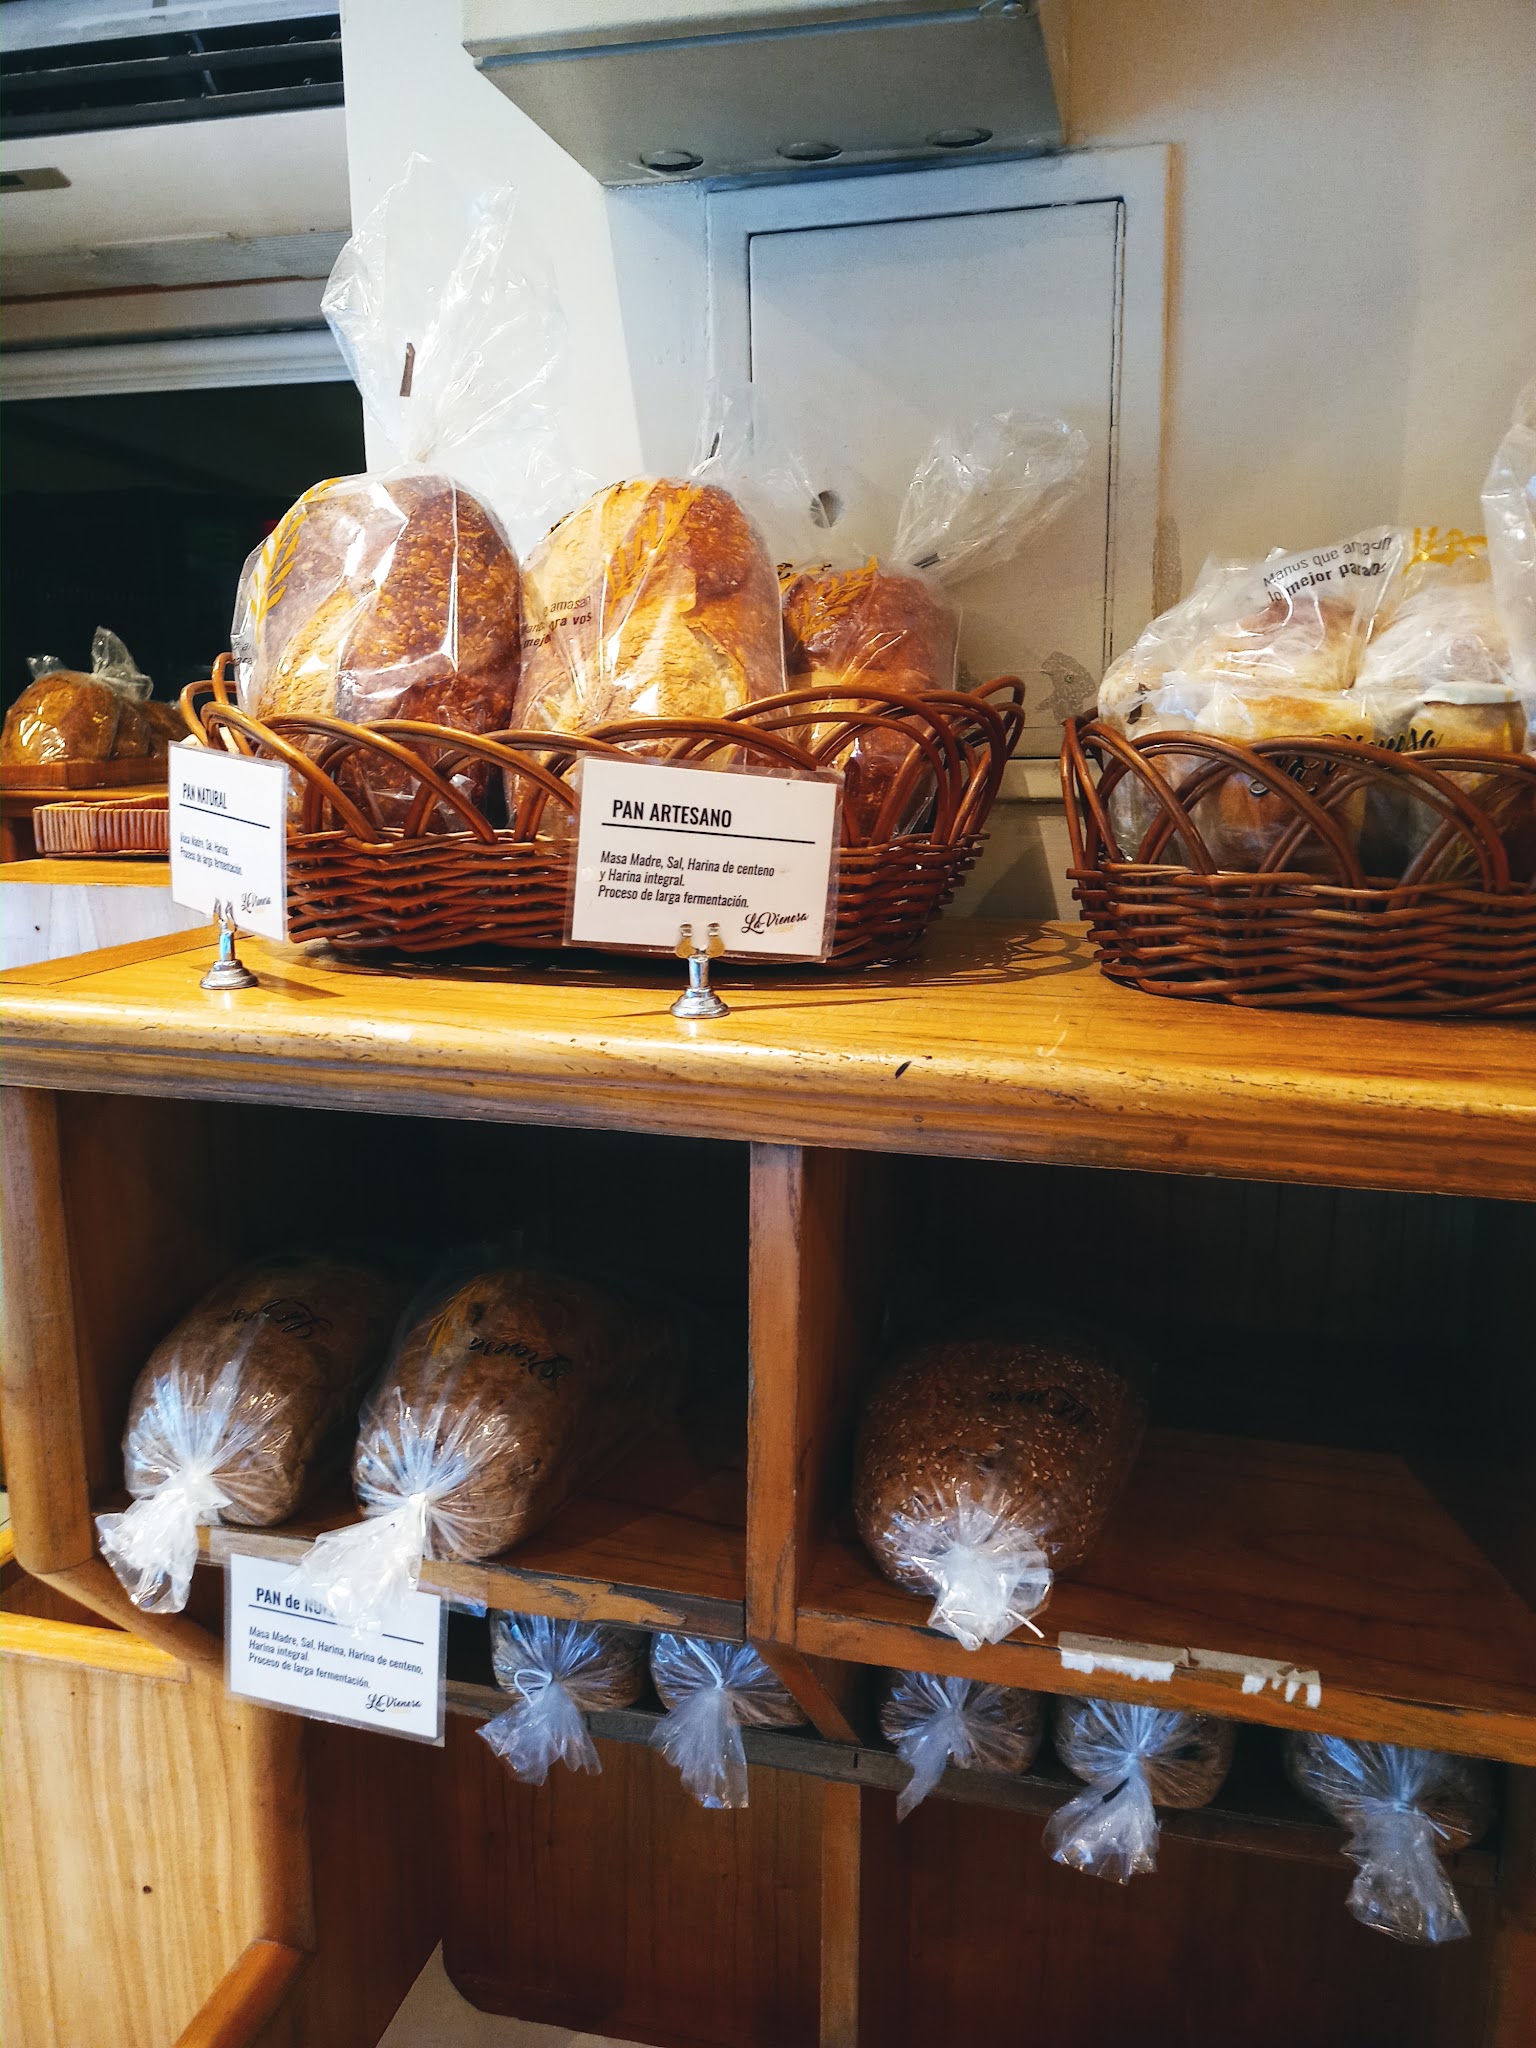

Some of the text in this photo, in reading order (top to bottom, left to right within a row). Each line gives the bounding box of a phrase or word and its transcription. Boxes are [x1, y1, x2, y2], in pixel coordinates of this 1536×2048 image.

[1312, 549, 1339, 567] que
[1268, 590, 1282, 603] lo
[1285, 571, 1333, 597] mejor
[523, 634, 552, 652] mejo
[573, 612, 592, 626] vos
[183, 782, 227, 810] PAN NATURAL
[612, 799, 732, 828] PAN ARTESANO
[600, 850, 775, 877] Masa Madre, Sal, Harina de centeno
[599, 868, 685, 888] y Harina integral.
[598, 885, 749, 908] Proceso de larga fermentación.
[256, 1587, 281, 1606] PAN
[285, 1594, 300, 1610] de
[249, 1639, 275, 1654] Harina
[249, 1626, 424, 1675] Masa Madre, Sal, Harina, Harina de centeno,
[248, 1652, 370, 1689] Proceso de larga fermentación.
